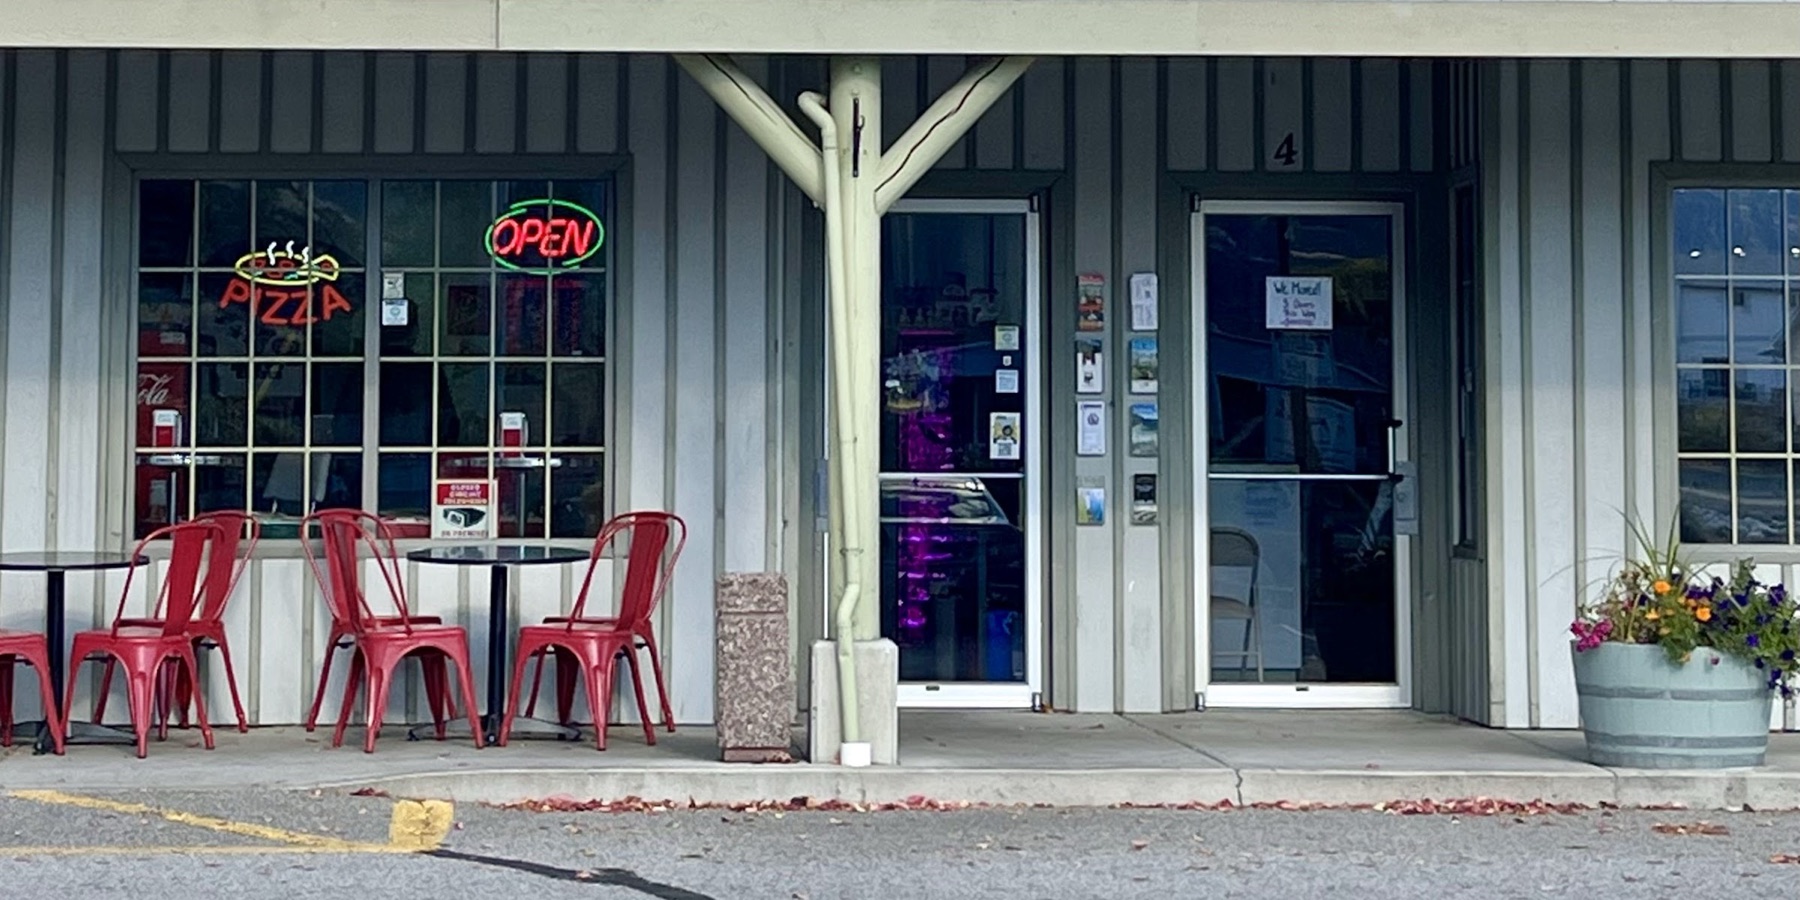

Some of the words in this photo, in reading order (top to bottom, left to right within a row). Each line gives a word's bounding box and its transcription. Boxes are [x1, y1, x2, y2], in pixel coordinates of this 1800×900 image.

[1273, 132, 1298, 166] 4
[492, 218, 594, 256] OPEN
[219, 278, 352, 325] PIZZA
[1273, 281, 1289, 296] We
